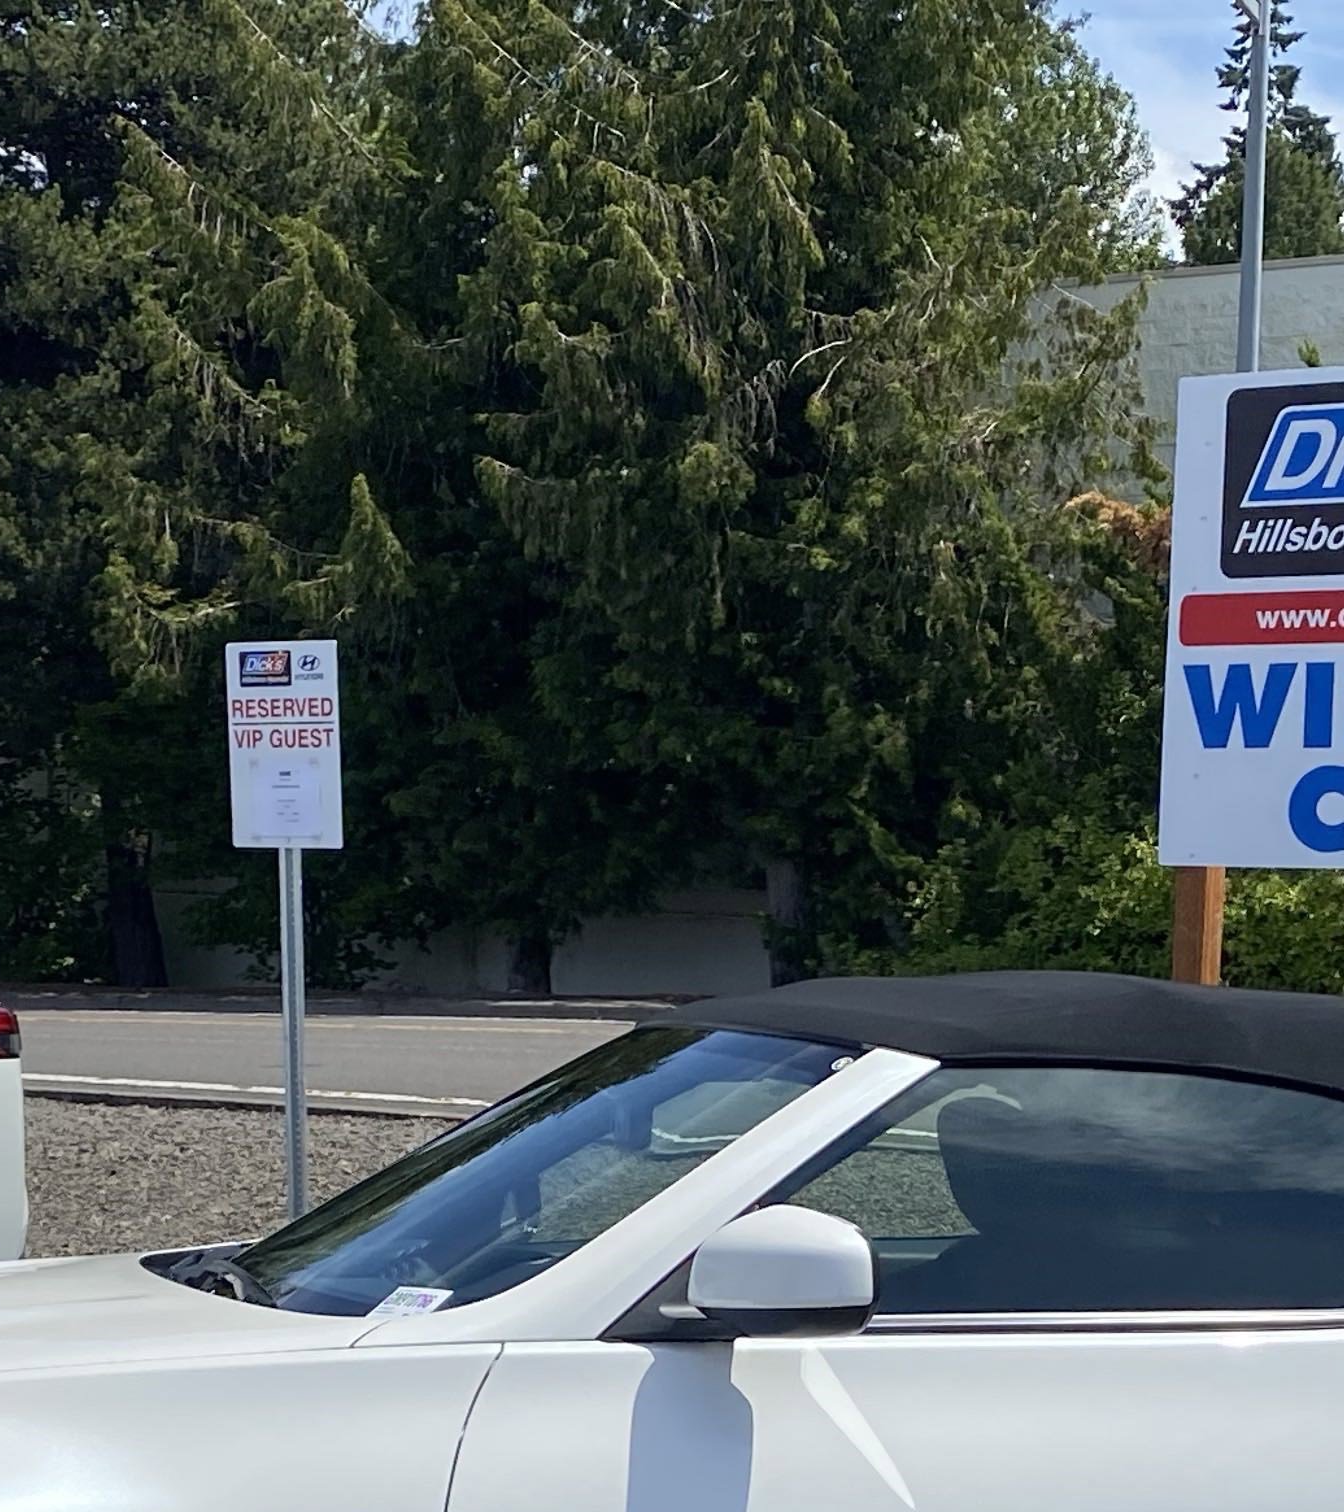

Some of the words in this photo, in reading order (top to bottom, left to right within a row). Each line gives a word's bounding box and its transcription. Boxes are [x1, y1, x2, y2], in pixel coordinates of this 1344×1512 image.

[231, 697, 334, 719] RESERVED
[233, 729, 264, 749] VIP
[269, 728, 334, 749] GUEST
